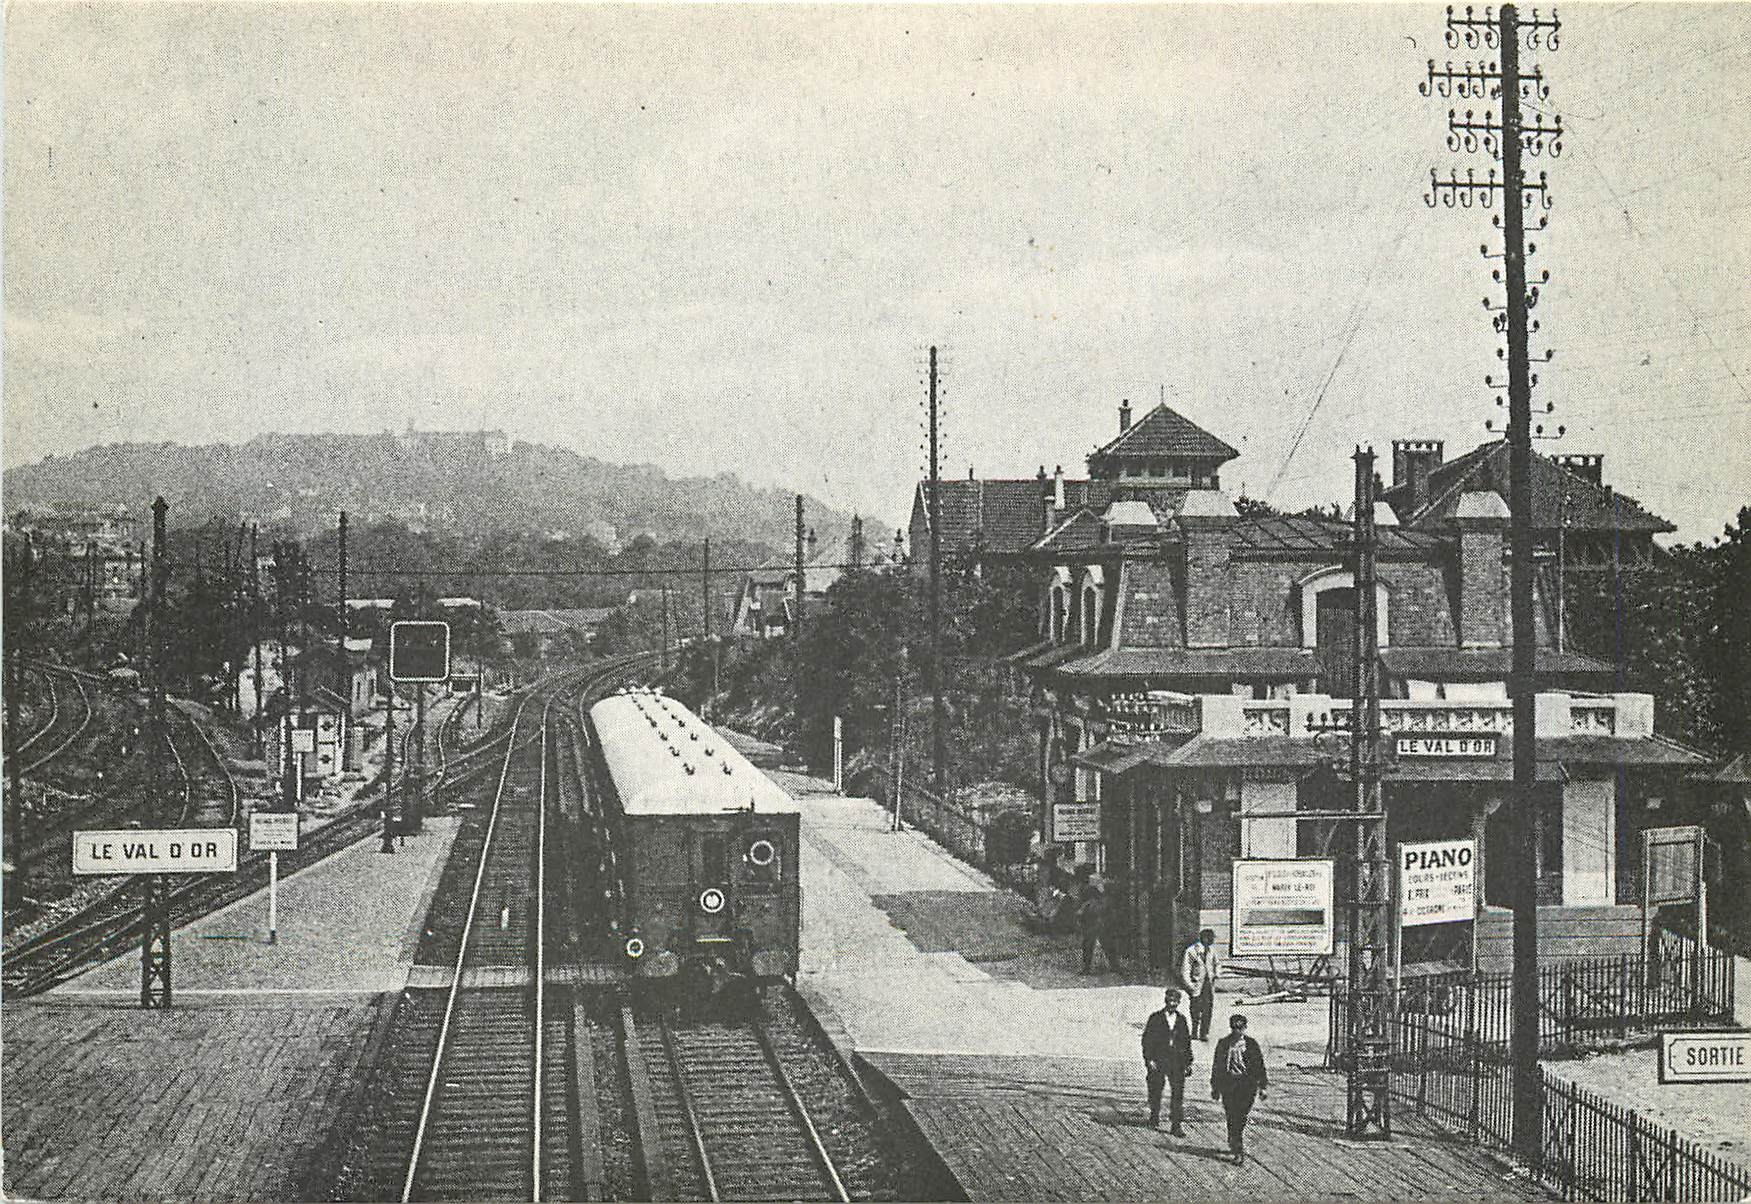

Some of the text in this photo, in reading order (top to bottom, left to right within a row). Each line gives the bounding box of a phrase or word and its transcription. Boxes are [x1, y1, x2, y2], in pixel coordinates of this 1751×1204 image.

[1400, 740, 1418, 753] LE
[1424, 740, 1454, 753] VAL
[91, 843, 112, 860] LE
[123, 843, 159, 859] VAL
[1405, 848, 1472, 870] PIANO
[1687, 1047, 1744, 1066] SORTIE
